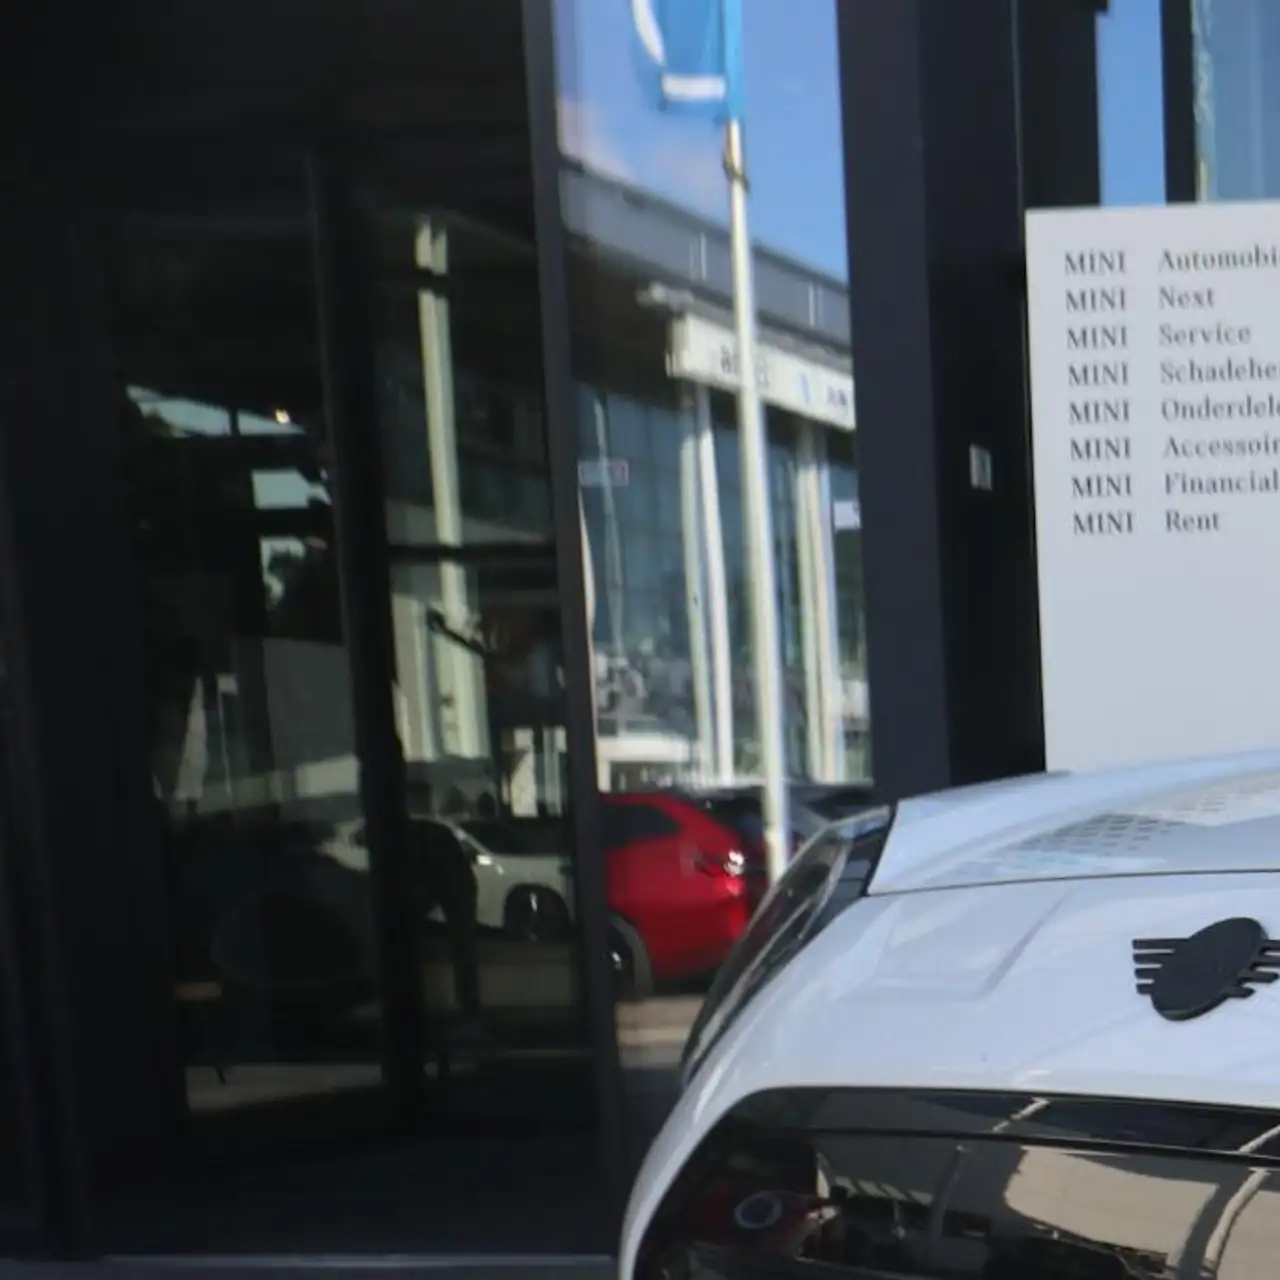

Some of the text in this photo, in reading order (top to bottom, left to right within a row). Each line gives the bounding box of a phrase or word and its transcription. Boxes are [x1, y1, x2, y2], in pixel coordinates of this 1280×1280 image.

[1064, 250, 1125, 274] MINI
[1065, 286, 1214, 312] MINI Next
[1067, 323, 1251, 349] MINI Service
[1068, 362, 1128, 386] MINI
[1069, 399, 1130, 424] MINI
[1070, 437, 1131, 461] MINI
[1071, 473, 1132, 498] MINI
[1165, 467, 1279, 495] Financial
[1073, 509, 1220, 535] MINI Rent
